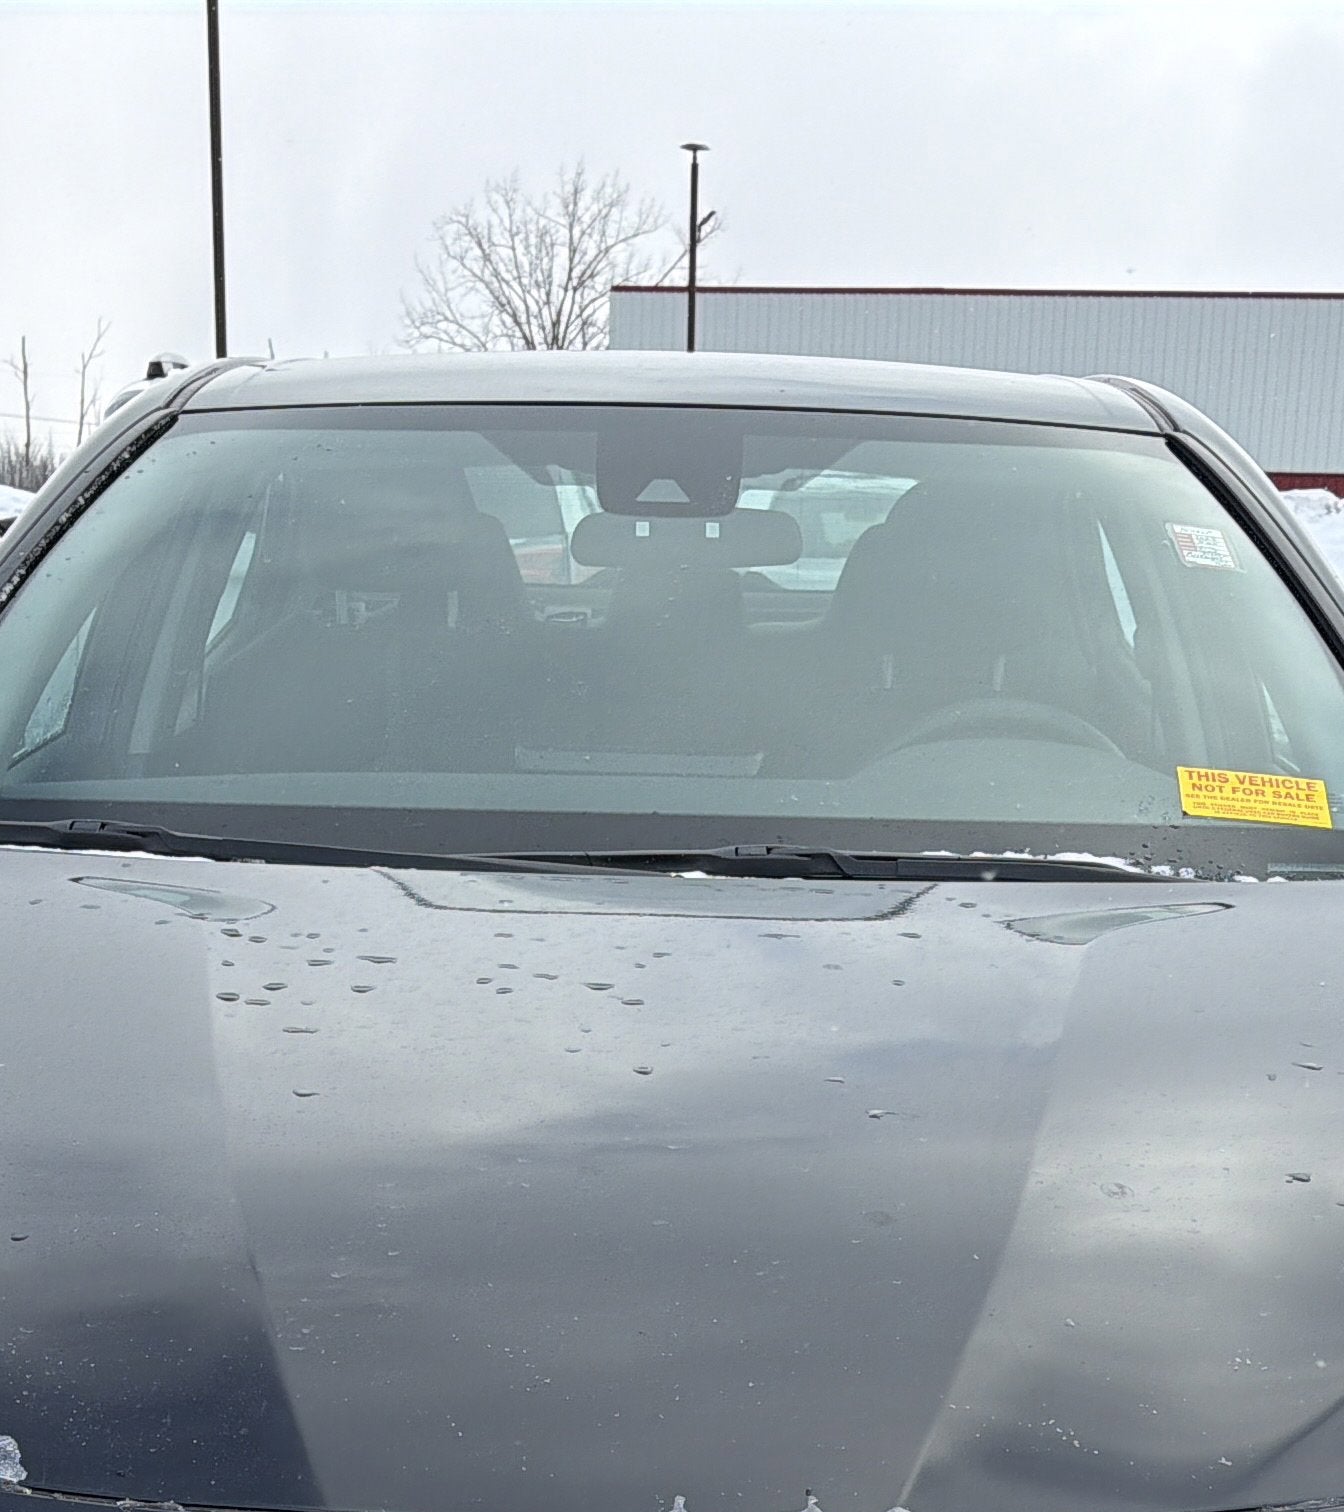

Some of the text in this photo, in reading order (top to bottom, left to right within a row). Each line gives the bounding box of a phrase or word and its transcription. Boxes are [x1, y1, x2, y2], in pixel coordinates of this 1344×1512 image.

[1185, 770, 1318, 792] THIS VEHICLE
[1191, 782, 1225, 793] NOT
[1231, 786, 1266, 797] FOR
